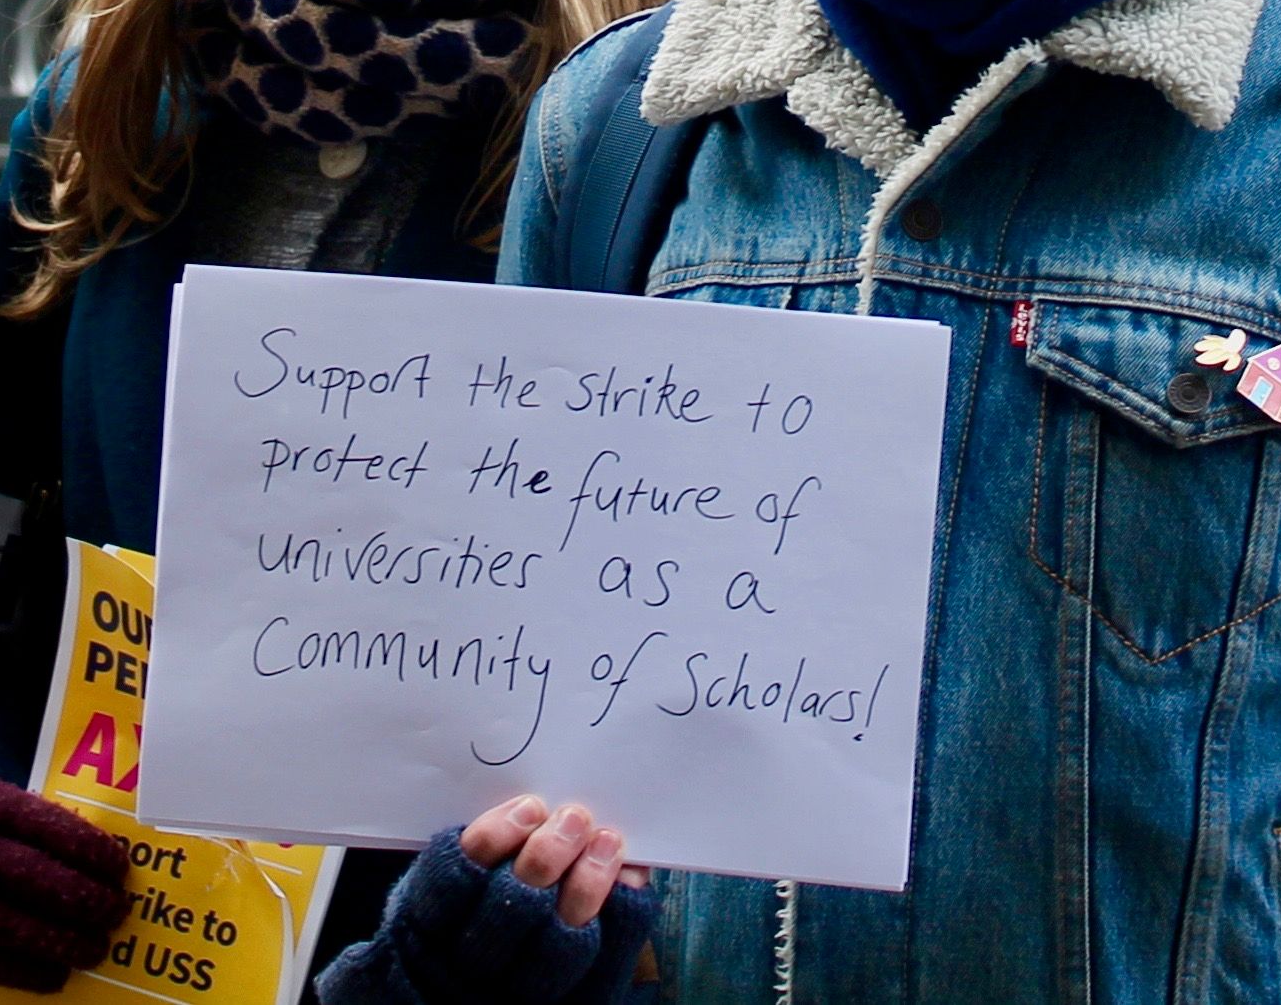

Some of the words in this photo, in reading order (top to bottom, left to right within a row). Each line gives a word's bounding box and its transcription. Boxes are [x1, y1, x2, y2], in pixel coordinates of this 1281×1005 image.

[234, 328, 431, 419] Support
[468, 356, 541, 410] the
[746, 382, 814, 436] to
[261, 434, 430, 493] protect
[470, 437, 552, 501] the
[559, 450, 735, 552] future
[755, 476, 822, 556] of
[258, 528, 543, 593] universities
[597, 555, 679, 607] as
[725, 571, 777, 614] a
[84, 640, 148, 699] PE
[590, 631, 670, 727] of
[114, 834, 187, 879] ort
[128, 887, 194, 933] rike
[203, 910, 237, 946] to
[144, 943, 216, 992] USS
